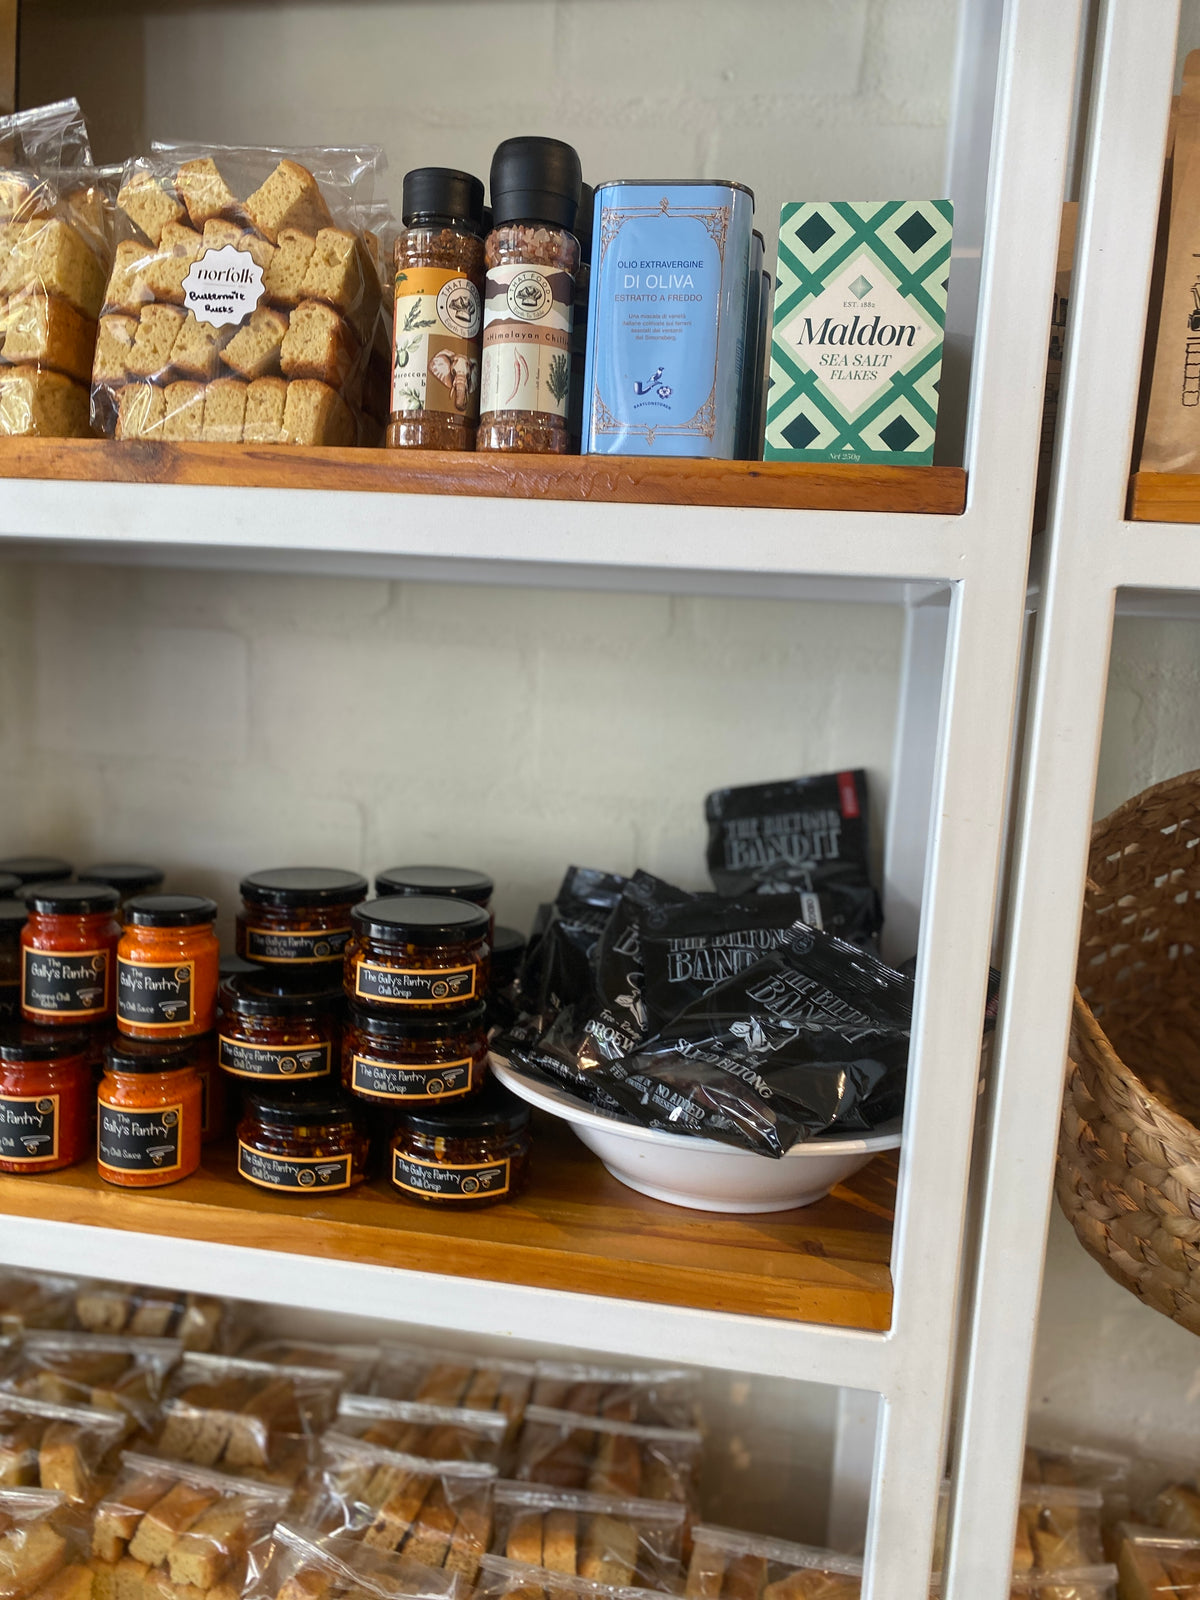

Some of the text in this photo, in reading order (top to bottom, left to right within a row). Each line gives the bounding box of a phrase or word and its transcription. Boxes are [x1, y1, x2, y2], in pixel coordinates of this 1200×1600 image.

[617, 260, 704, 269] OLIO EXTRAVERGINE
[198, 267, 254, 283] norfolk
[624, 274, 694, 289] DI OLIVA
[441, 280, 462, 297] THAT
[510, 274, 551, 295] THAT FOOD
[614, 294, 703, 302] ESTRATTO A FREDDO
[490, 330, 540, 340] Himalayan
[796, 315, 916, 347] Maldon
[819, 353, 893, 367] SEA SALT
[830, 369, 878, 381] FLAKES
[724, 829, 842, 870] BANDIT
[667, 928, 784, 952] THE BILTON
[48, 957, 61, 968] The
[62, 965, 97, 981] Pantry
[131, 967, 143, 978] The
[363, 969, 377, 983] The
[403, 974, 431, 990] Pantry
[144, 976, 181, 994] Pantry
[776, 969, 819, 995] THE
[223, 1042, 233, 1054] The
[254, 1050, 280, 1065] Pantry
[360, 1063, 372, 1077] The
[398, 1069, 426, 1085] Pantry
[6, 1110, 44, 1128] Pantry
[117, 1113, 130, 1124] The
[131, 1122, 168, 1139] Pantry
[242, 1148, 252, 1164] The
[272, 1160, 299, 1177] Pantry
[398, 1157, 410, 1173] The
[433, 1169, 460, 1185] Pantry
